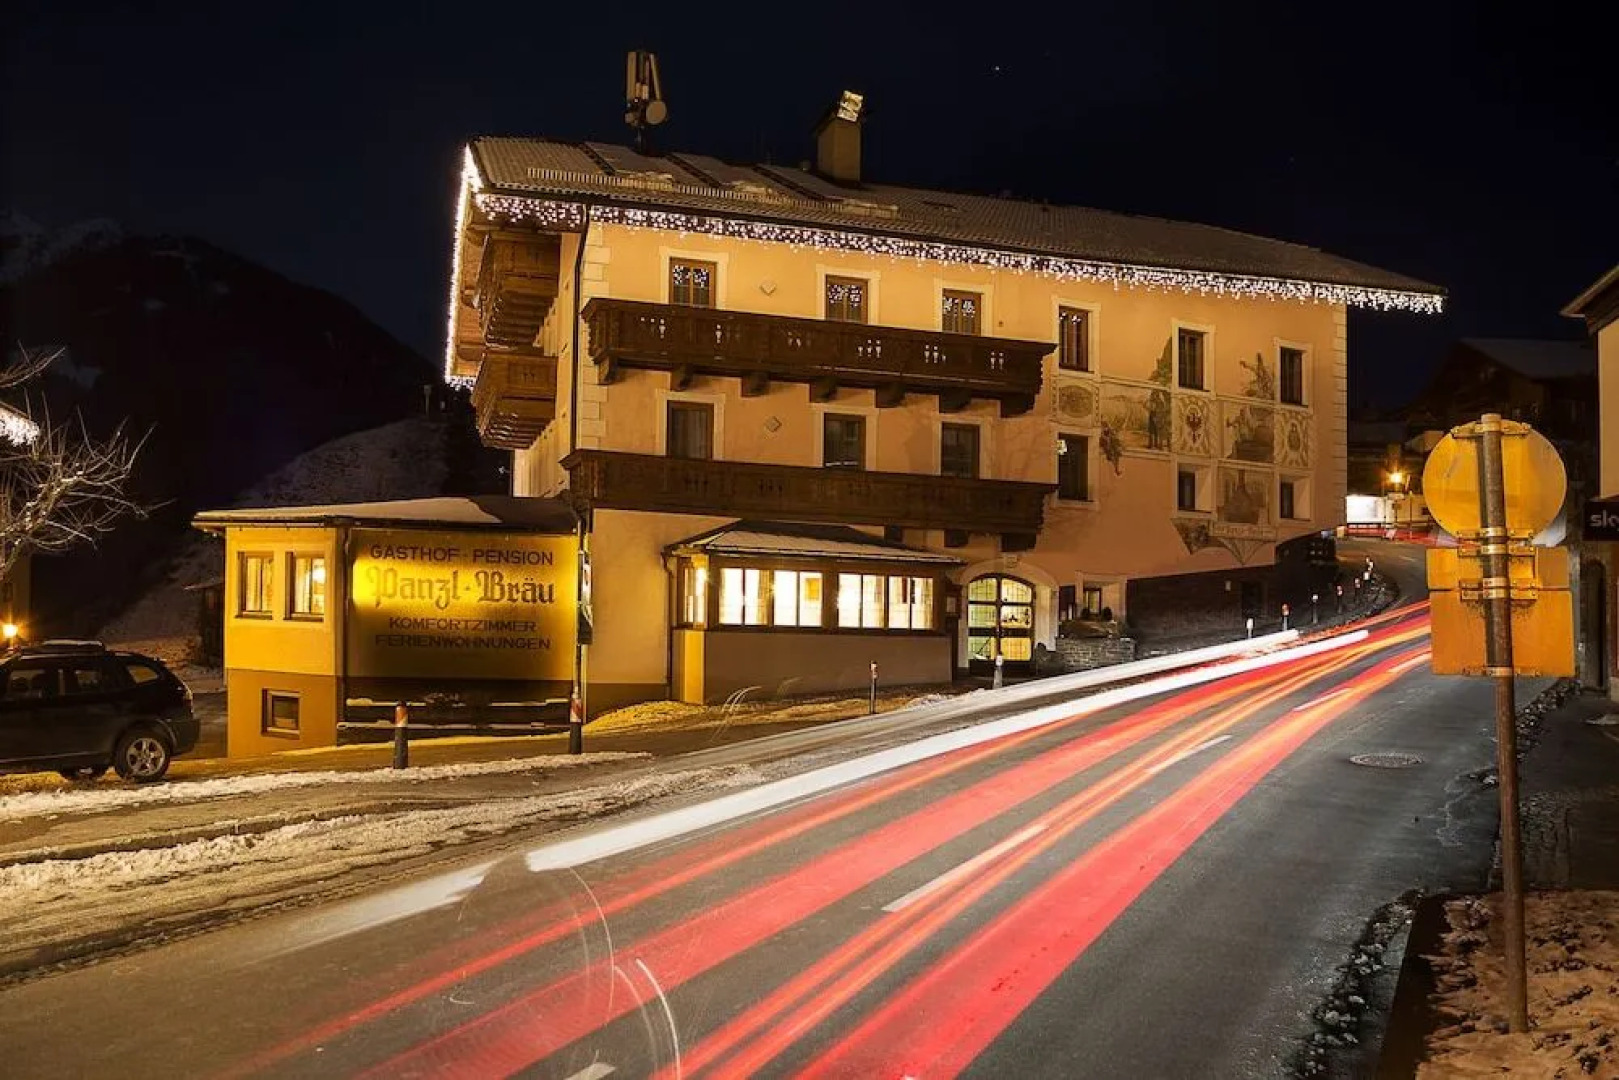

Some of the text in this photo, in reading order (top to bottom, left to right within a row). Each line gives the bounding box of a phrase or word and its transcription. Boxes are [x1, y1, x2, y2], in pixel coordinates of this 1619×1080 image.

[370, 543, 553, 566] GASTHOF PENSION
[366, 565, 556, 610] Panzl Bräu
[388, 616, 538, 632] KOMFORTZIMMER
[375, 634, 551, 650] FERIENWOHNUNGEN
